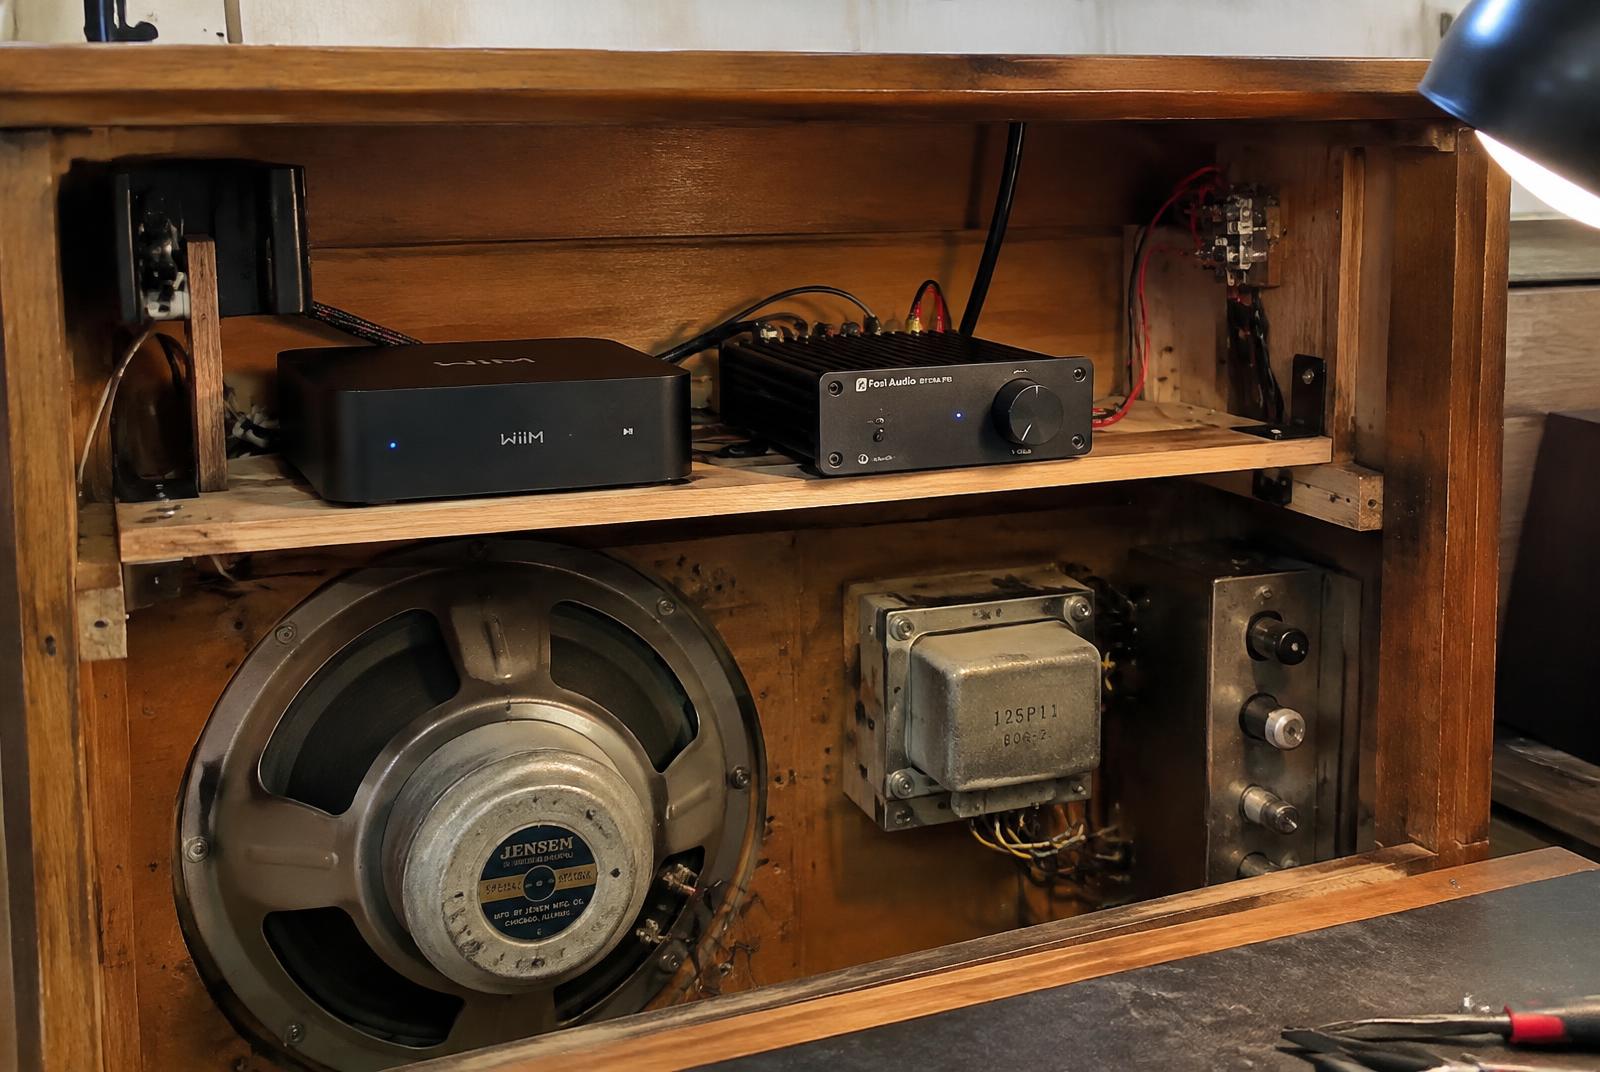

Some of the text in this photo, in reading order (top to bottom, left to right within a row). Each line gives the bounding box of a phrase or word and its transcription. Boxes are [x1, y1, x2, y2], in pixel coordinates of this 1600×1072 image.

[889, 376, 917, 387] Audio
[500, 430, 544, 446] WiiM
[500, 836, 574, 860] JENSEM
